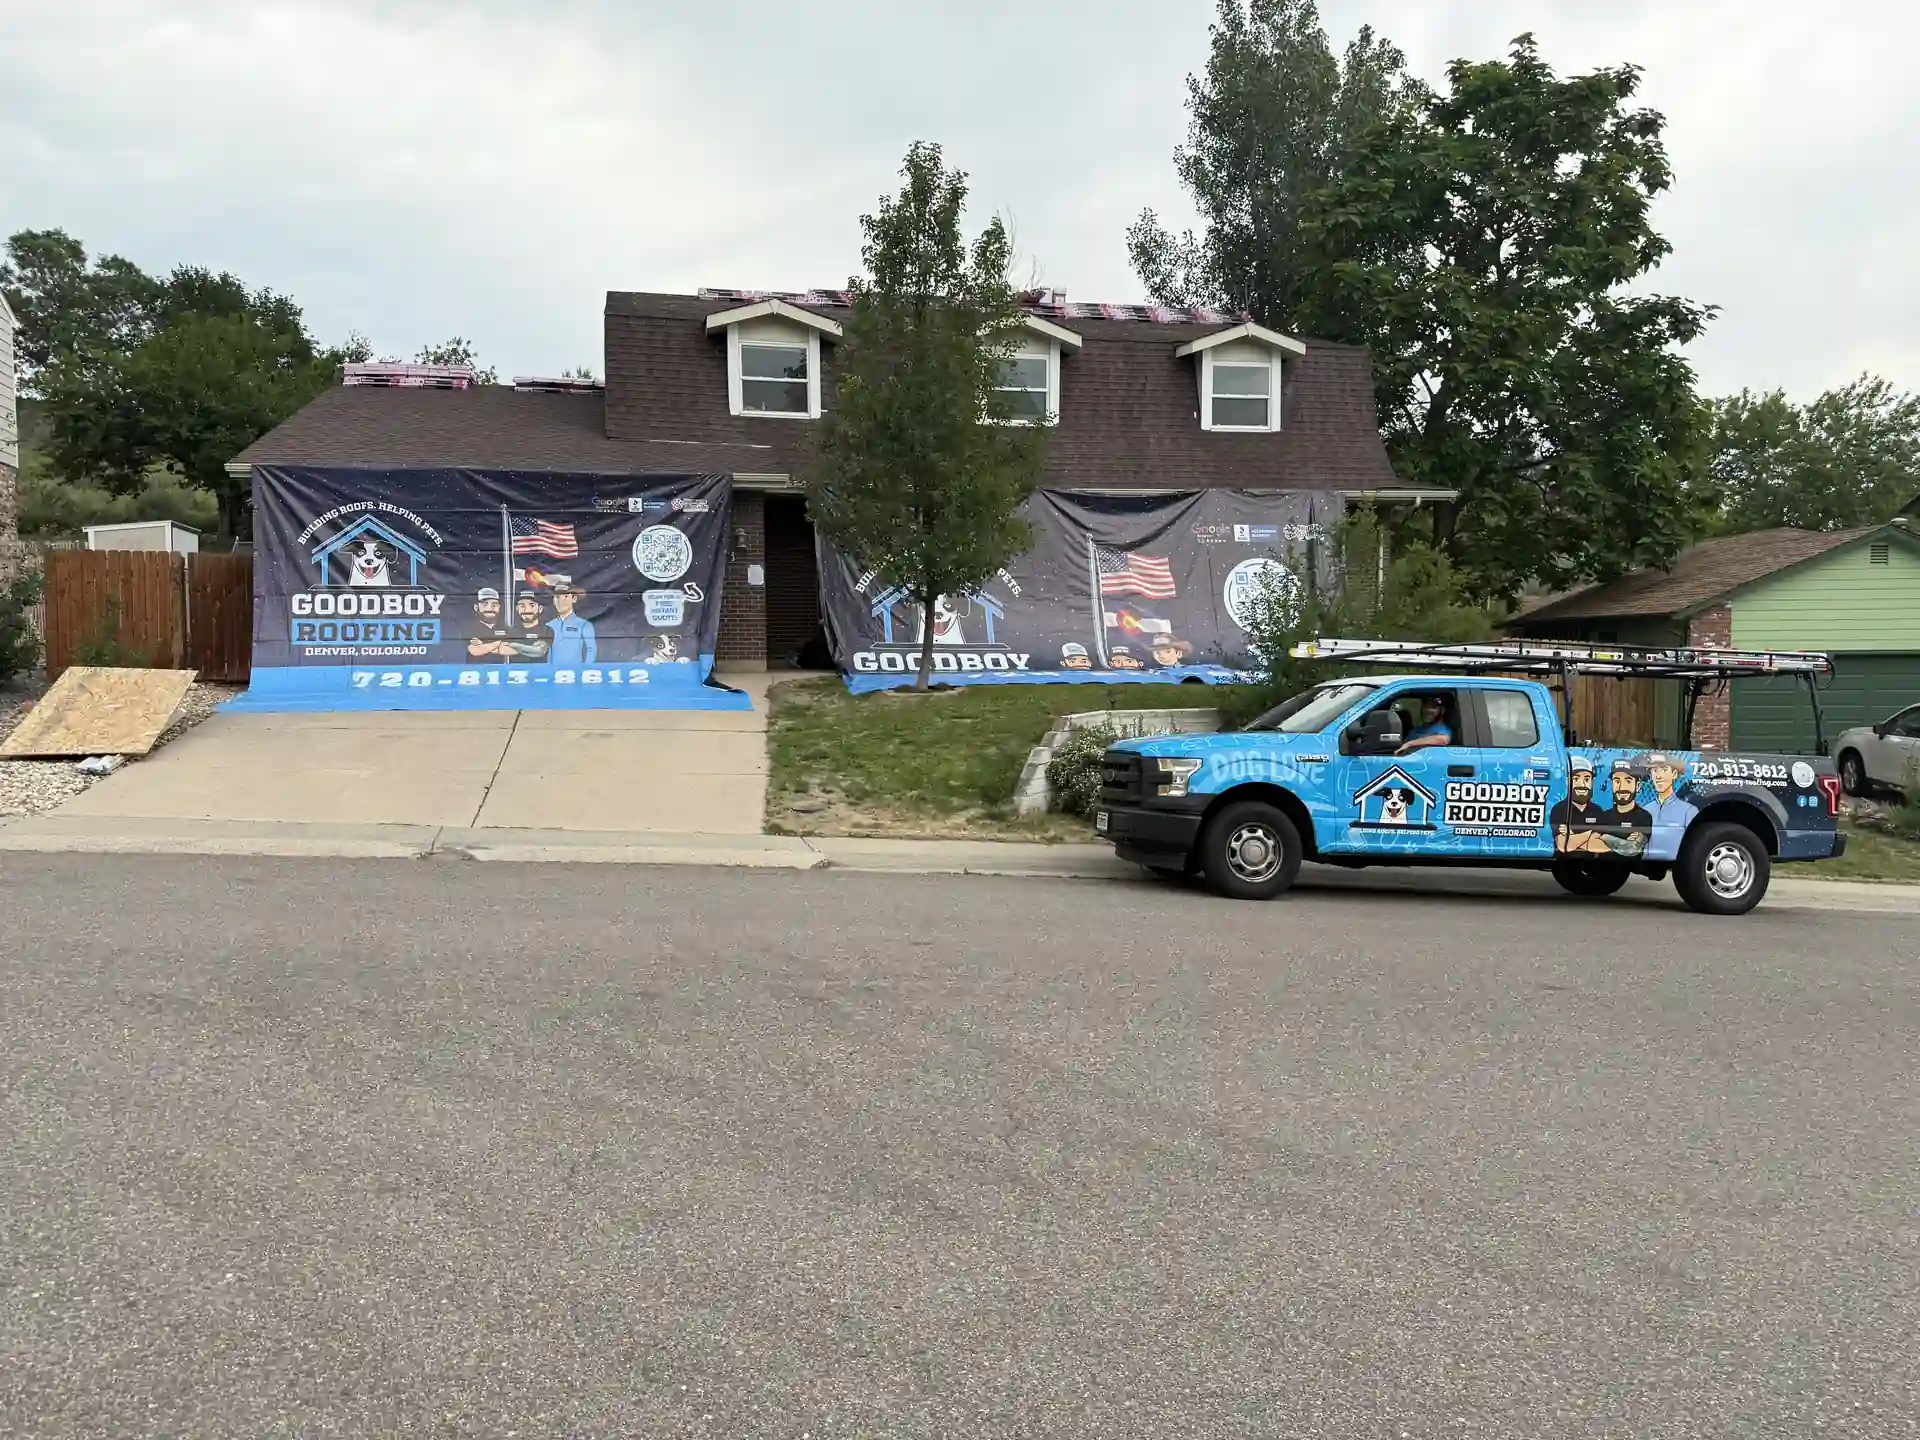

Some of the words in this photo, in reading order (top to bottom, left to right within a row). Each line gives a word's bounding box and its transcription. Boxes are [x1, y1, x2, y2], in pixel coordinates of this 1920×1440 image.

[298, 509, 339, 545] BUILDING
[339, 501, 377, 515] ROOFS.
[378, 502, 422, 526] HELPING
[420, 520, 443, 547] PETS.
[997, 567, 1022, 598] PETS.
[292, 593, 445, 615] GOODBOY
[296, 622, 436, 642] ROOFING
[305, 646, 359, 657] DENVER,
[361, 646, 428, 656] COLORADO
[853, 652, 1031, 672] GOODBOY
[352, 669, 650, 688] 720-813-8612
[1210, 750, 1263, 782] DOG
[1269, 751, 1325, 785] LOVE
[1690, 762, 1788, 779] 720-813-8612
[1446, 783, 1549, 803] GOODBOY
[1448, 805, 1542, 824] ROOFING
[1455, 828, 1492, 837] DENVER,
[1493, 829, 1536, 838] COLORADO
